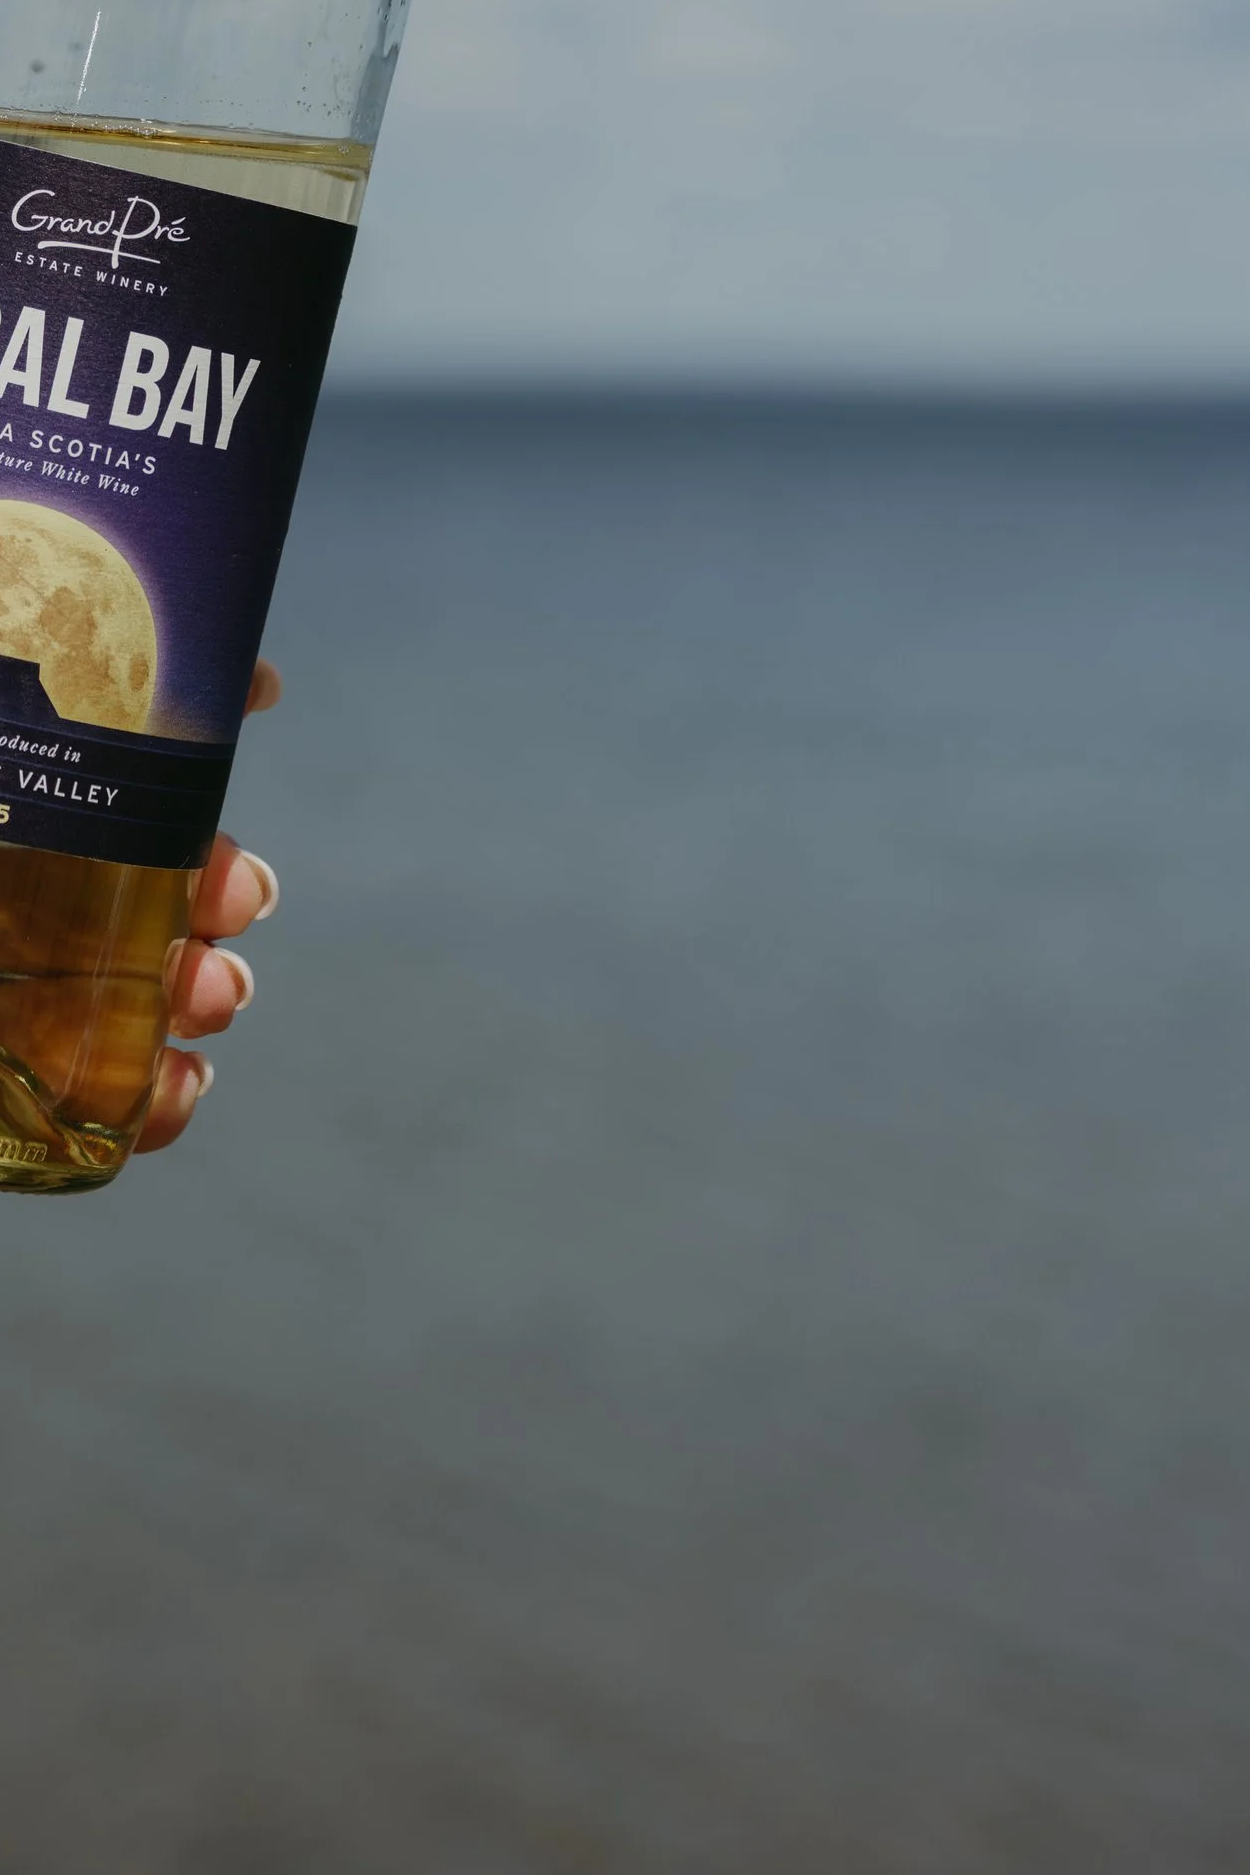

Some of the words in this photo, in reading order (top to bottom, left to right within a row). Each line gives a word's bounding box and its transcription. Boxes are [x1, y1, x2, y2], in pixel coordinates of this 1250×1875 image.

[11, 189, 116, 236] Grand
[111, 196, 191, 270] Pré
[14, 251, 83, 277] ESTATE
[95, 270, 169, 297] WINERY
[108, 331, 262, 451] BAY
[28, 429, 157, 475] SCOTIA'S
[40, 460, 91, 486] White
[97, 473, 140, 497] Wine
[63, 744, 82, 764] in
[18, 768, 119, 807] VALLEY
